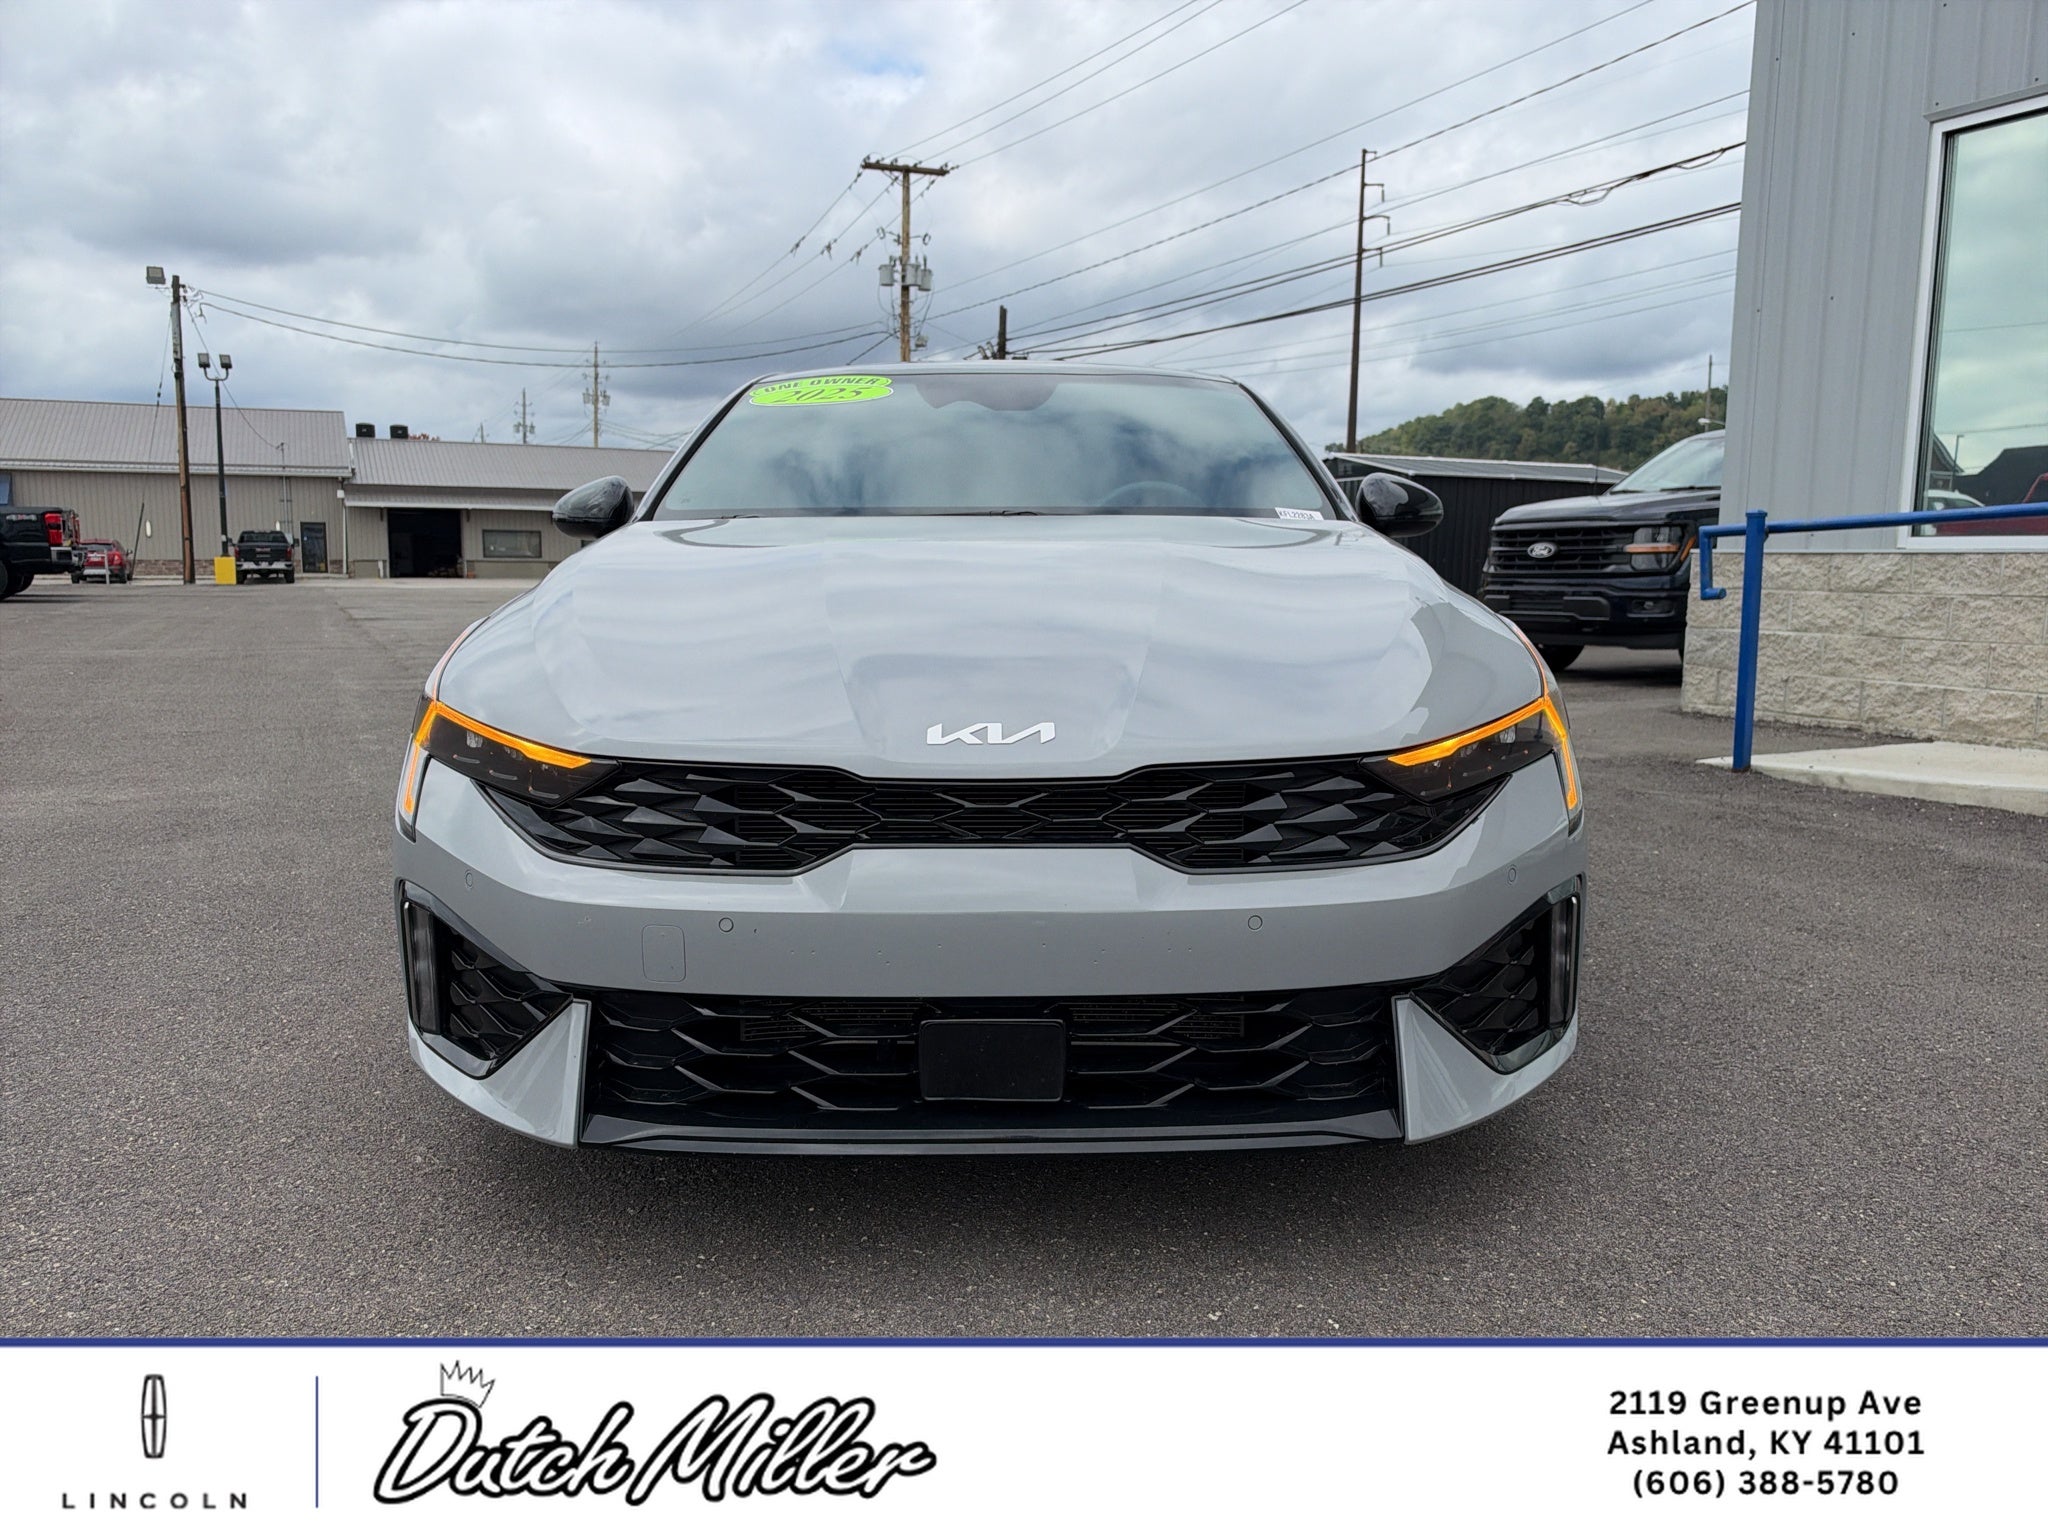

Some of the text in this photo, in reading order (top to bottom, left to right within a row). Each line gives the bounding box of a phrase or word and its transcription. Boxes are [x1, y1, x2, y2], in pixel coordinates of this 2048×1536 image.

[764, 377, 880, 393] ONE OWNER
[769, 387, 872, 403] 2025
[927, 722, 1056, 745] KIA
